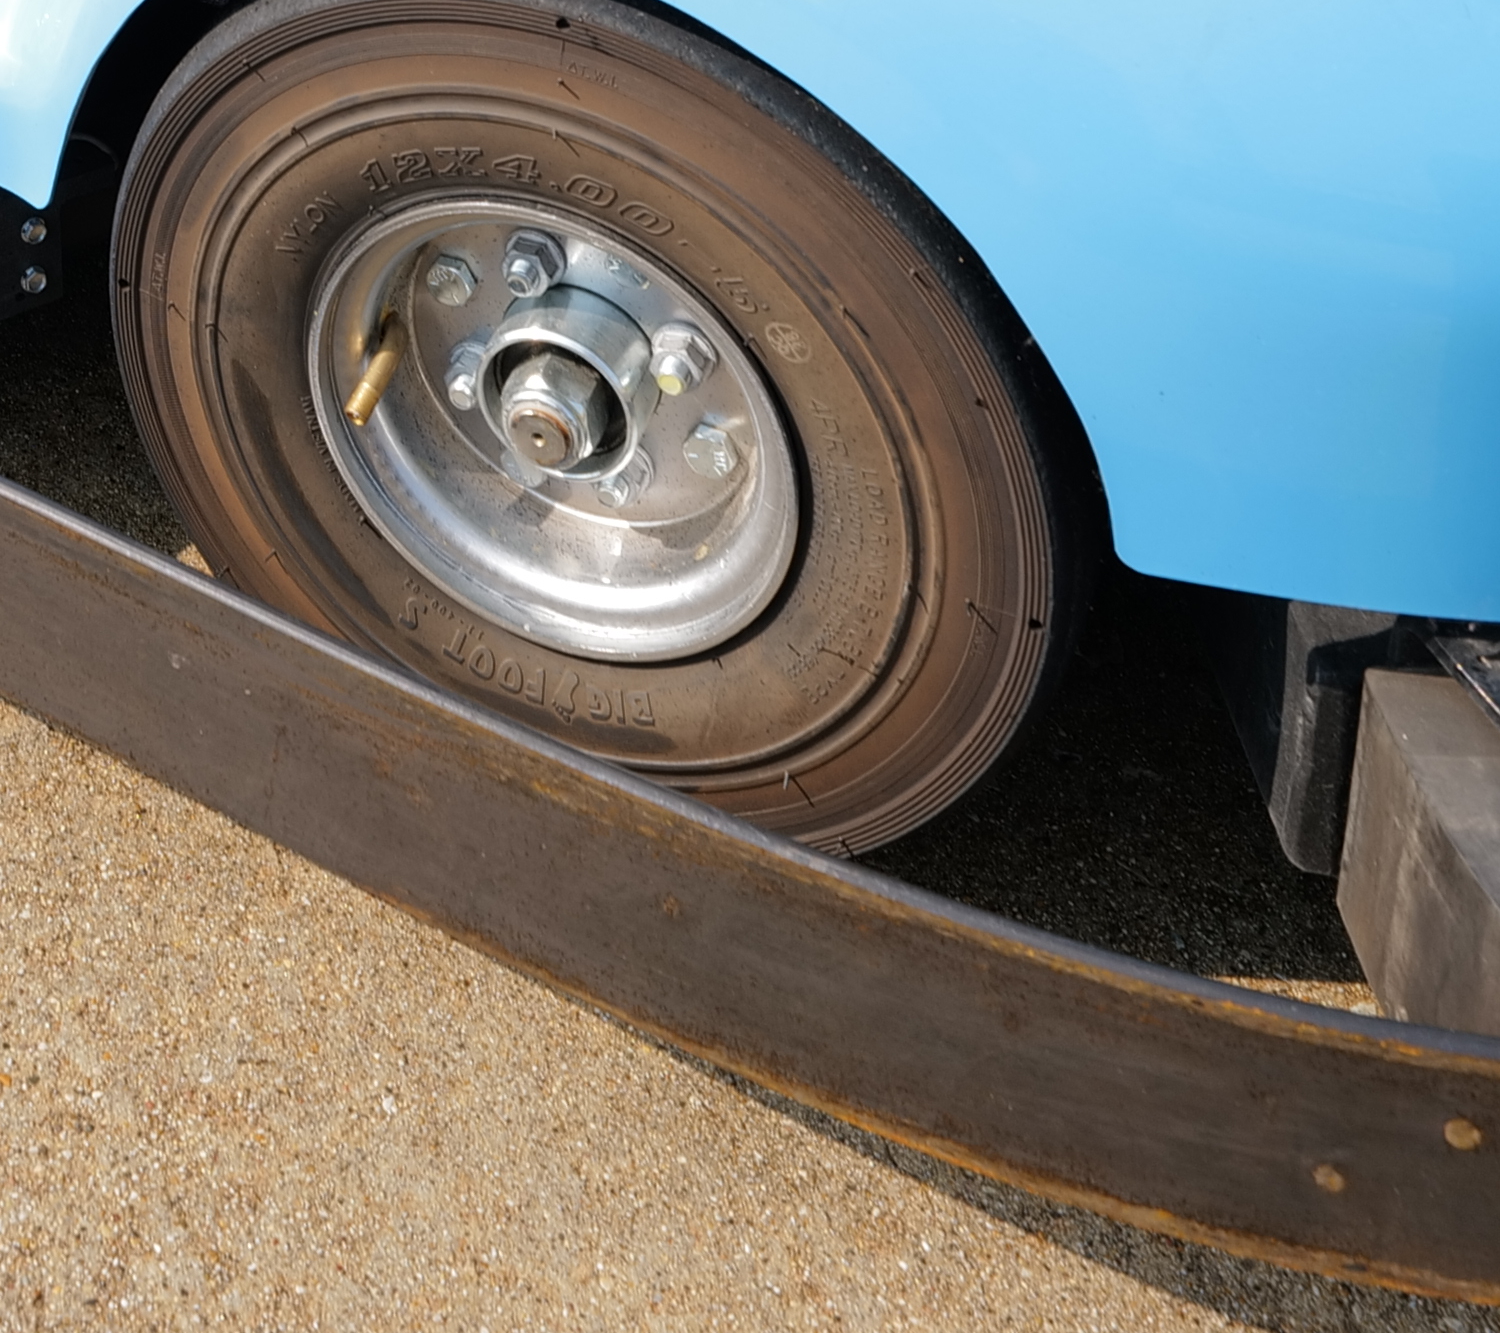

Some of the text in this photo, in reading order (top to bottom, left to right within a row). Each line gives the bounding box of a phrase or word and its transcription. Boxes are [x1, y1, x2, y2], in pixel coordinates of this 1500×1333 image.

[860, 468, 888, 526] LOAD
[437, 627, 546, 706] FOOT
[588, 687, 653, 729] BIG
